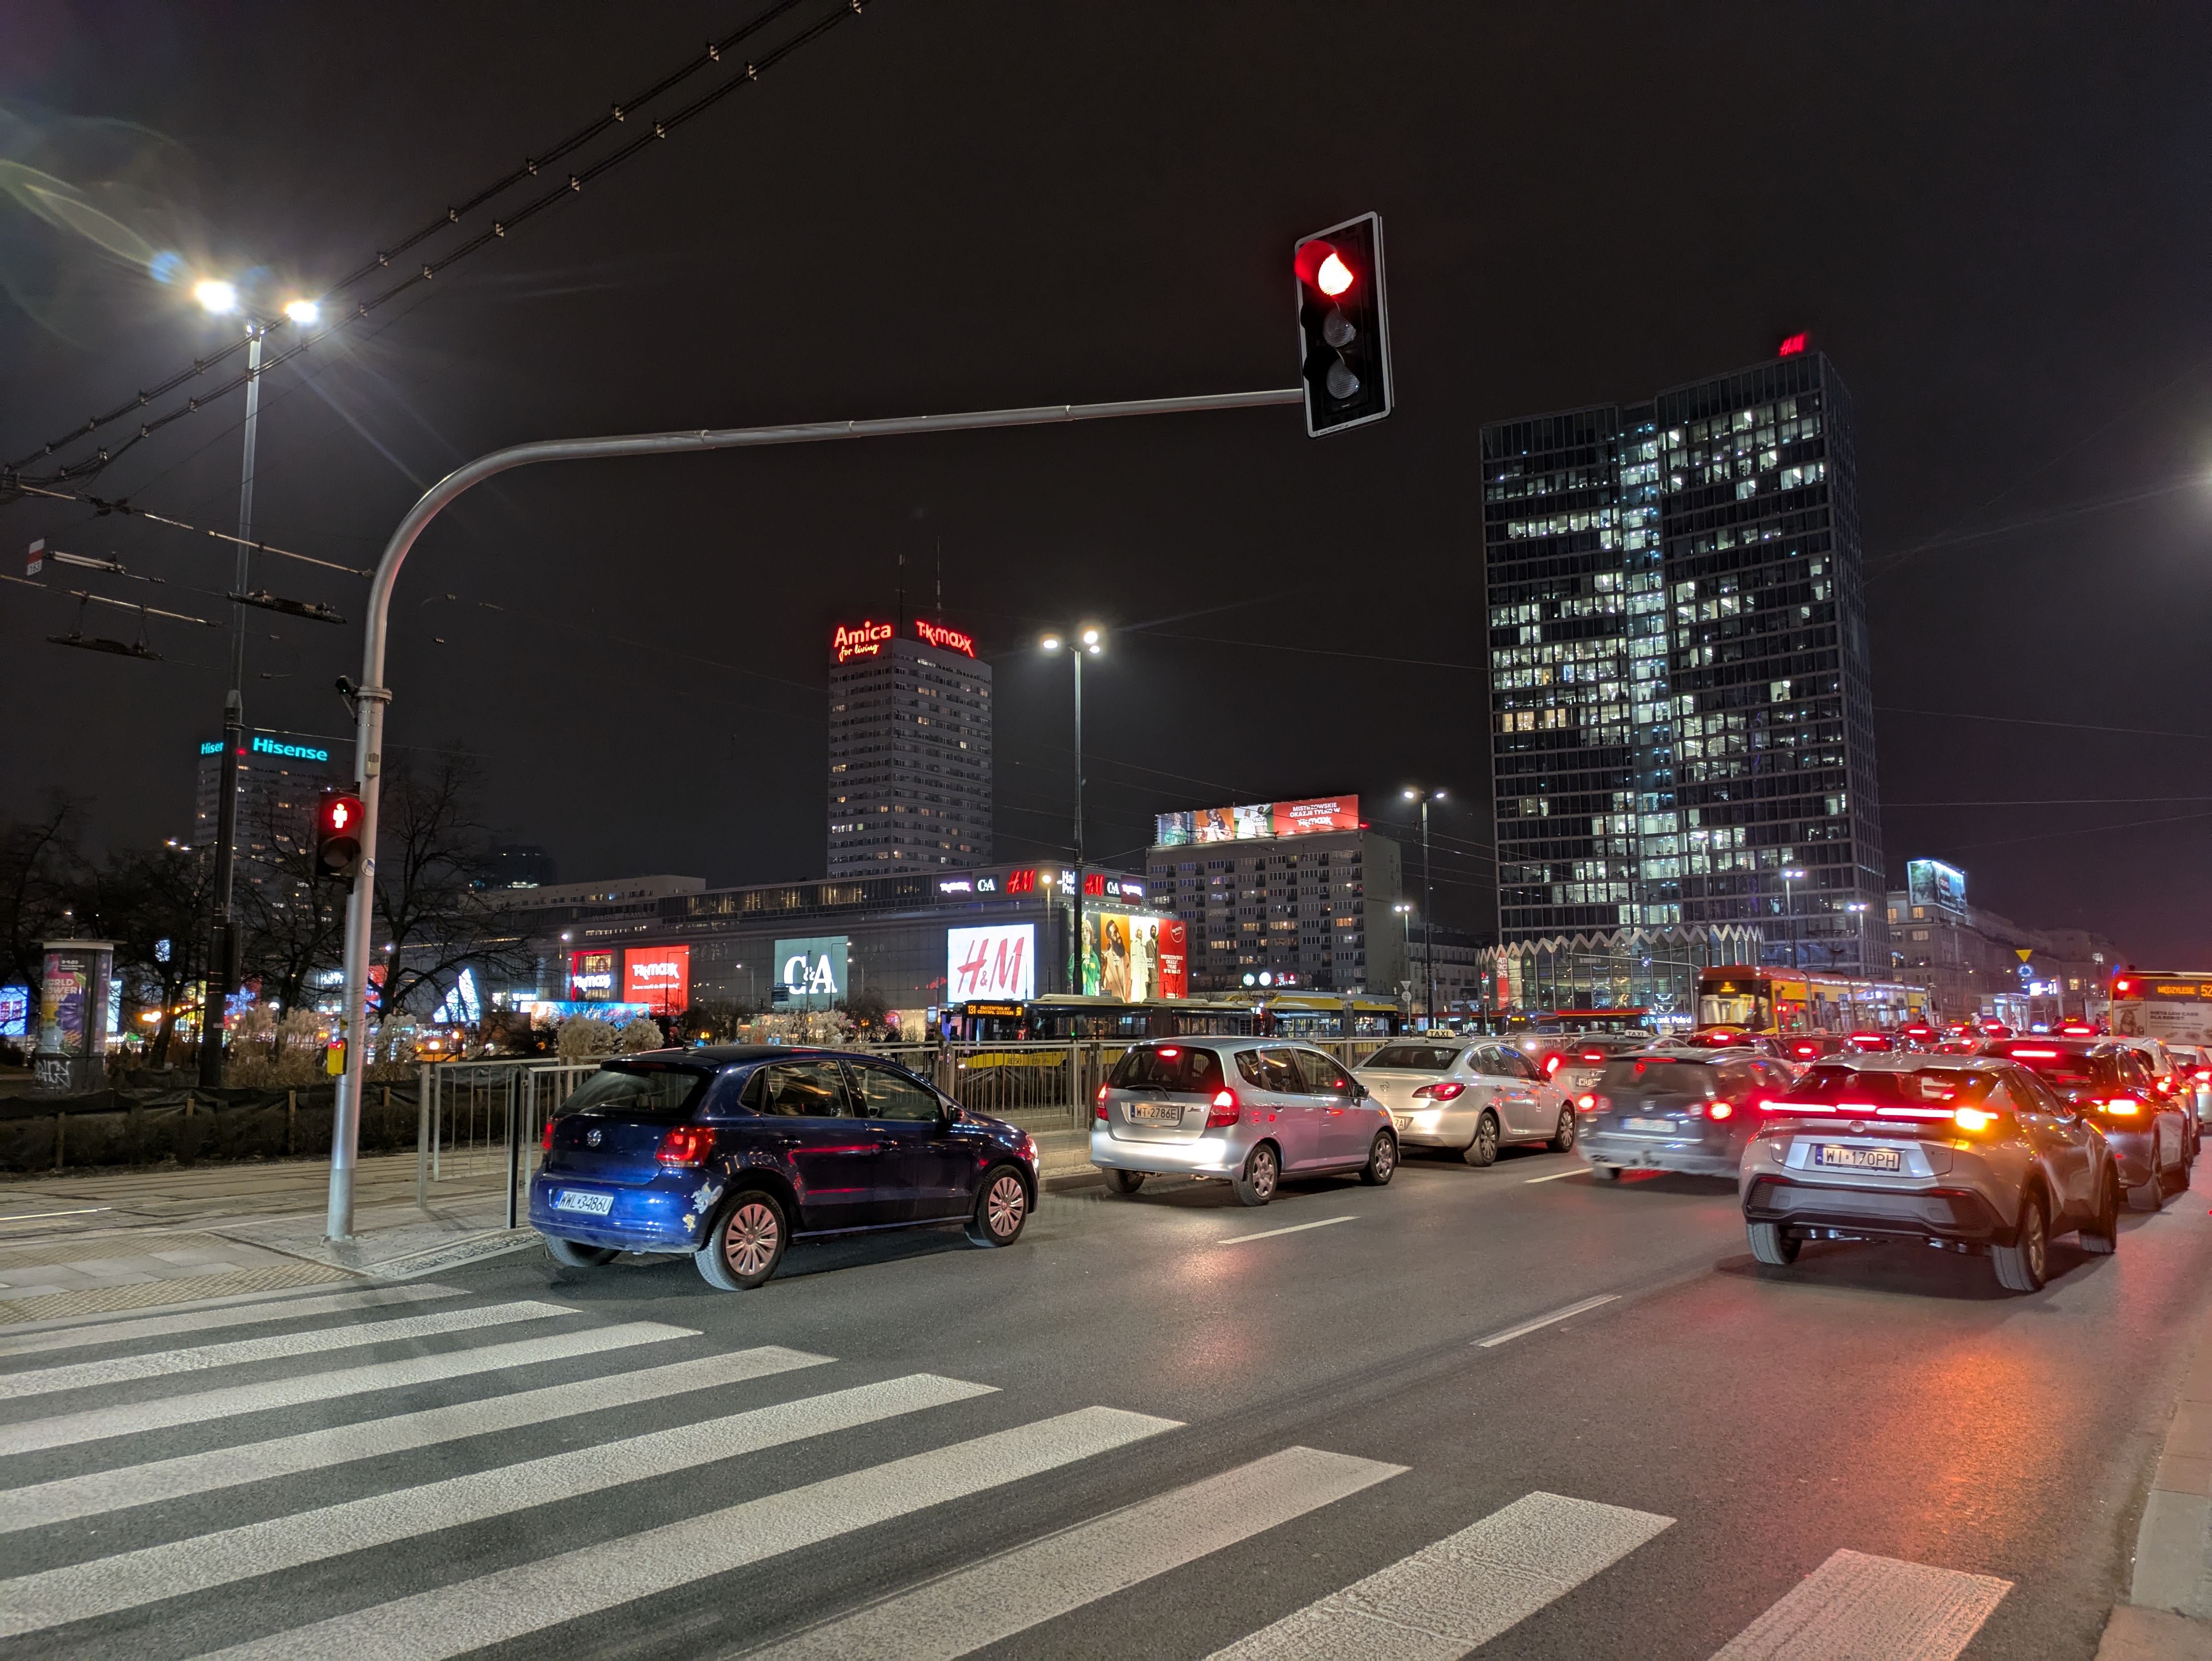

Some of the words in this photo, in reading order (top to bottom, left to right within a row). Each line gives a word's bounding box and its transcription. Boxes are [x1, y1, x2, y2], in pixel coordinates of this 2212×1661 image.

[834, 621, 891, 648] Amica
[839, 645, 853, 662] for
[854, 643, 880, 655] living
[253, 738, 328, 761] Hisense
[1293, 802, 1337, 811] MISTRZOWSKIE
[977, 878, 995, 892] C&A
[1006, 869, 1035, 894] H&M
[1062, 870, 1075, 884] Hal
[1084, 874, 1105, 896] H&M
[1062, 883, 1075, 895] Pric
[784, 955, 838, 995] C&A
[957, 936, 1025, 996] H&M
[2201, 984, 2212, 997] 52
[968, 1005, 976, 1014] 131
[1137, 1107, 1148, 1118] WT
[1150, 1108, 1176, 1119] 2786E
[1826, 1149, 1842, 1163] WI
[1851, 1151, 1896, 1168] 170PH
[559, 1193, 576, 1208] WWL
[578, 1195, 612, 1212] 3486U
